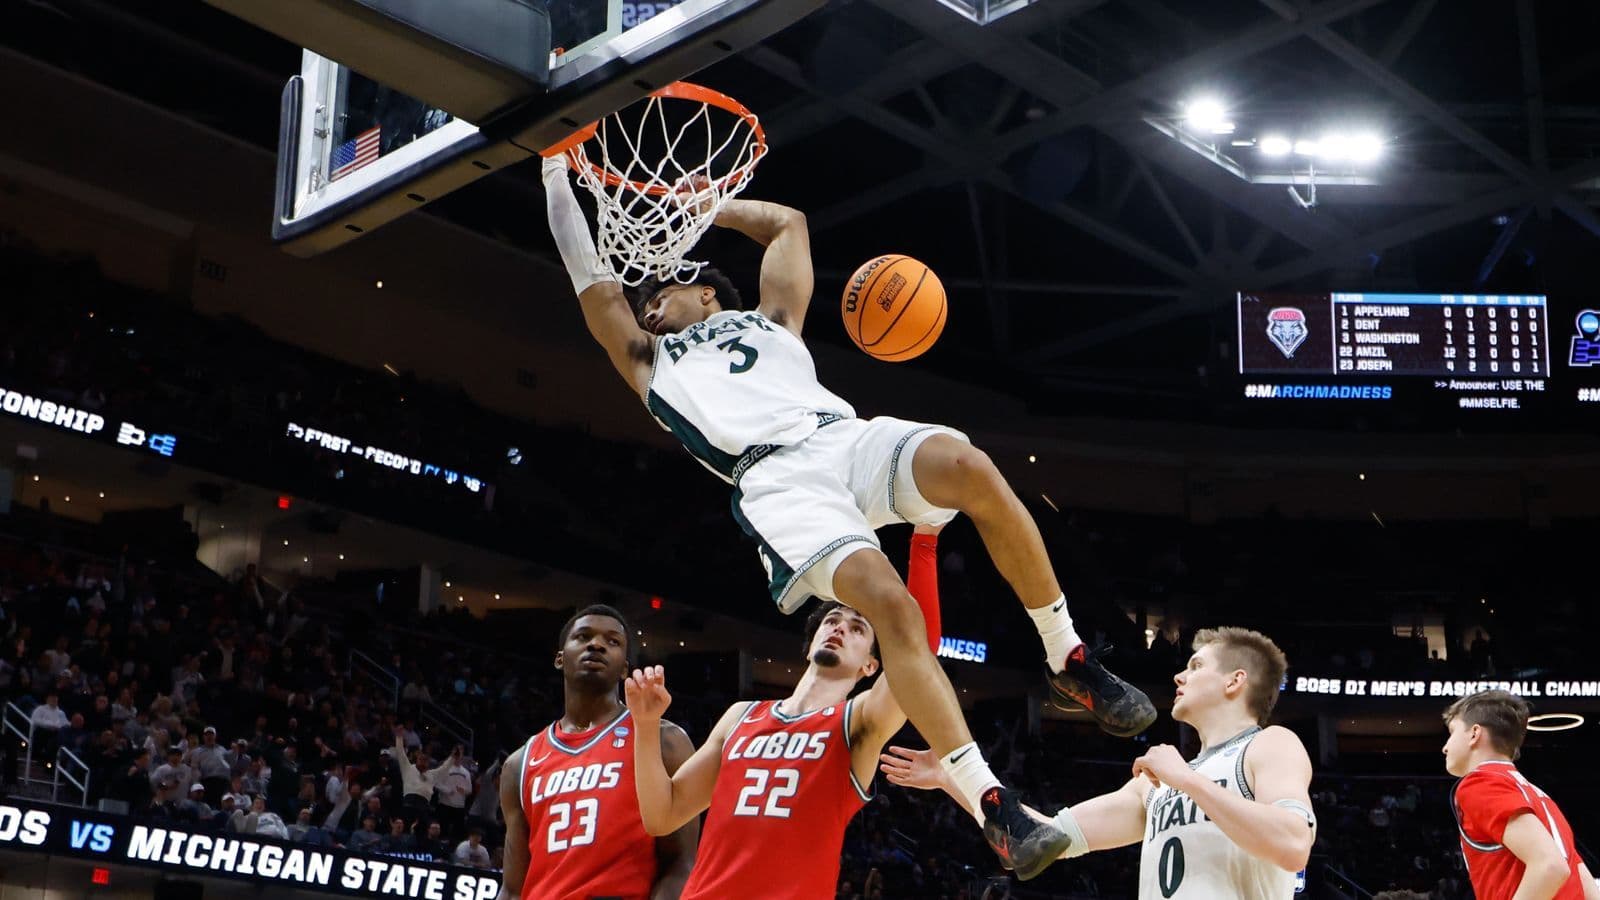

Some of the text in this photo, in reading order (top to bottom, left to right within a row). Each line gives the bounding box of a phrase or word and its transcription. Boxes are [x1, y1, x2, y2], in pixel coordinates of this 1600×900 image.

[846, 257, 890, 313] Wilson
[1342, 306, 1537, 318] 1 APPELHANS 0 0 0 0 0
[1341, 319, 1537, 332] 2 DENT 4 1 3 0 0
[1342, 333, 1538, 346] 3 WASHINGTON 1 2 0 0 1
[716, 336, 759, 374] 3
[1339, 346, 1538, 359] 22 AMZIL 12 3 0 0 1
[1340, 360, 1539, 372] 23 JOSEPH 4 2 0 0 1
[1245, 384, 1392, 399] #MARCHMADNESS
[1449, 379, 1500, 391] Announcer:
[1502, 380, 1522, 391] USE
[1524, 380, 1545, 391] THE
[1459, 398, 1521, 409] #MMSELFIE.
[1296, 677, 1341, 694] 2025
[1345, 679, 1367, 695] DI
[1370, 680, 1425, 696] MEN'S
[1545, 681, 1600, 697] CHAM
[728, 731, 831, 760] LOBOS
[531, 762, 624, 804] LOBOS
[733, 768, 800, 818] 22
[547, 798, 599, 854] 23
[69, 820, 115, 853] VS
[127, 825, 334, 885] MICHIGAN
[341, 857, 448, 900] STATE
[1158, 836, 1185, 899] 0
